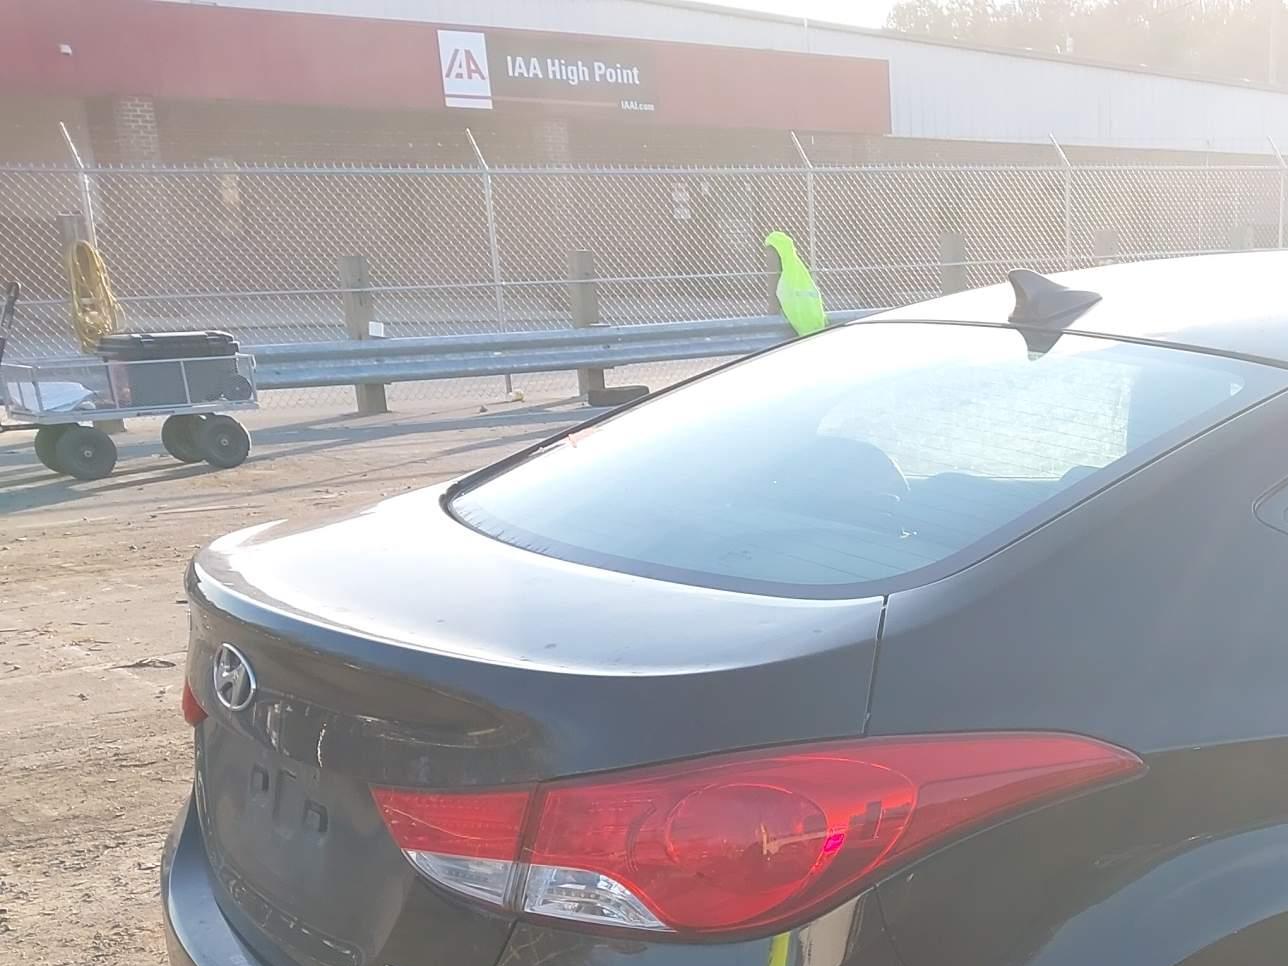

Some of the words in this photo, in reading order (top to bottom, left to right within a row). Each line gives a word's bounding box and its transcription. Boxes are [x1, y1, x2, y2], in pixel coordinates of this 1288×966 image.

[506, 55, 543, 78] IAA
[547, 58, 590, 85] High
[593, 61, 640, 85] Point
